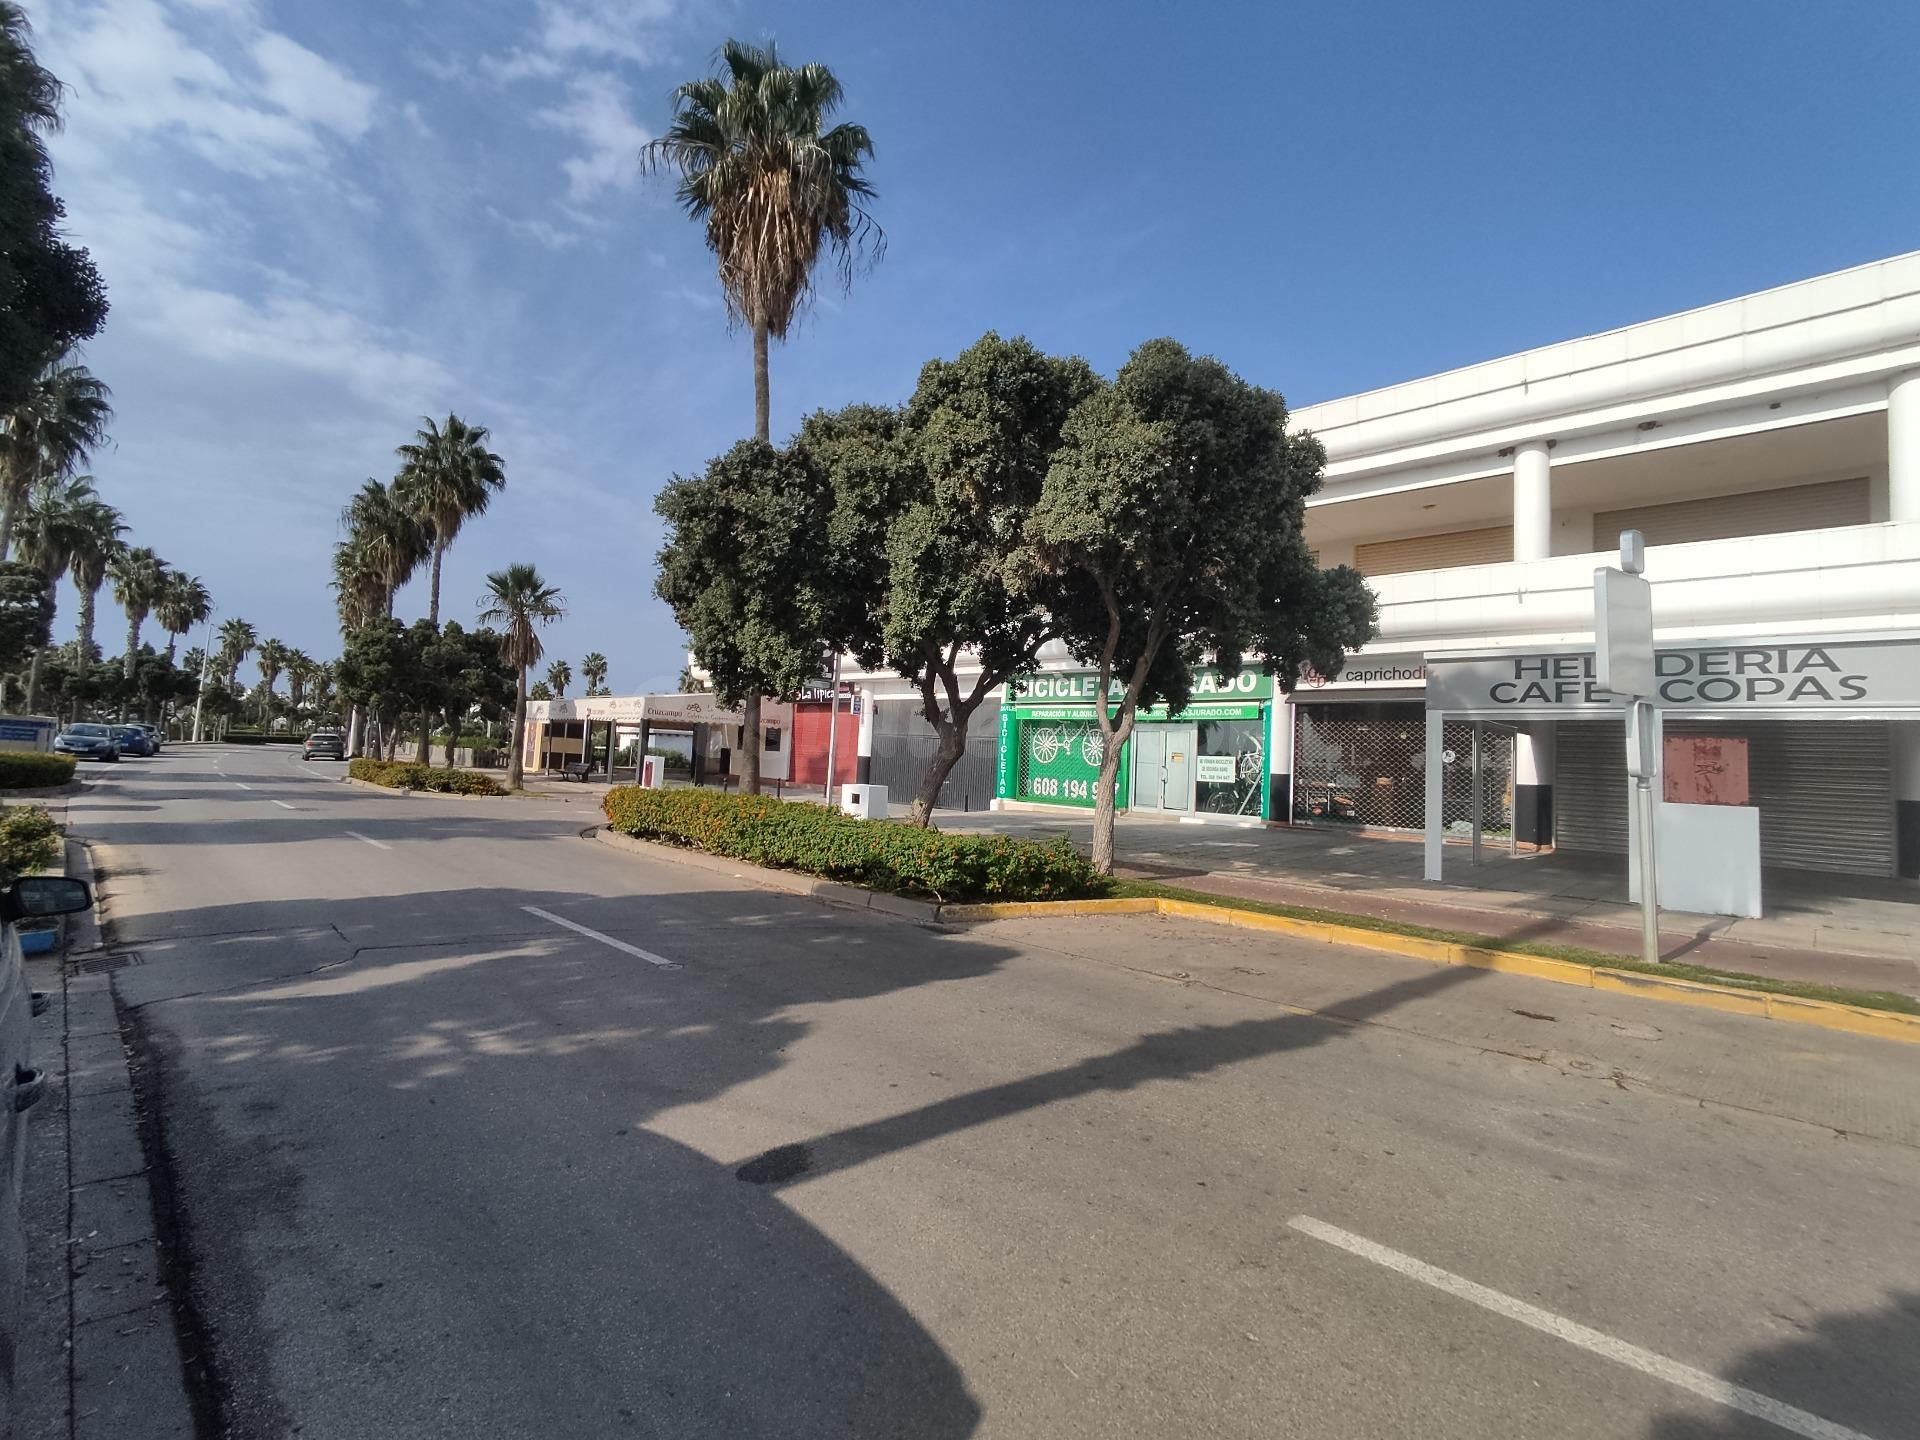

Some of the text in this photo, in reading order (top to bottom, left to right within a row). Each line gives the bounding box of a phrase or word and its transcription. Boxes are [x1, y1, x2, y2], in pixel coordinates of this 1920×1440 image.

[1514, 648, 1842, 680] HELDERIA
[1660, 676, 1868, 703] COPAS
[1072, 710, 1099, 718] ALQUILE
[999, 713, 1009, 795] BICICLETAS
[1033, 777, 1058, 797] 608
[1063, 779, 1088, 799] 194
